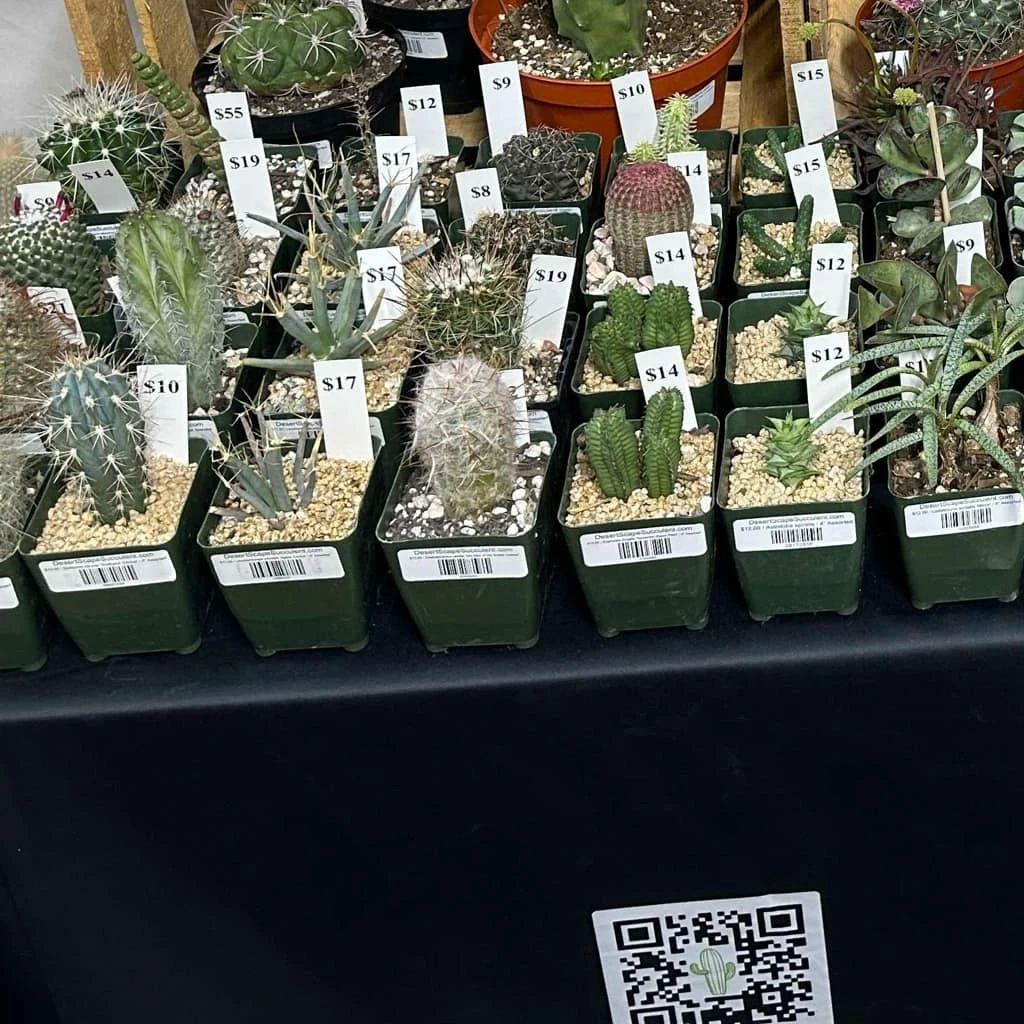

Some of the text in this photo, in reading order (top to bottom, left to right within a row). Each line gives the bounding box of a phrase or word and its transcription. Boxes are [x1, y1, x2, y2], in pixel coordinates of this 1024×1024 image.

[491, 76, 512, 90] $9
[797, 68, 825, 82] $15
[617, 83, 646, 100] $10
[407, 96, 437, 111] $12
[213, 106, 245, 120] $55
[229, 154, 261, 170] $19
[381, 151, 412, 167] $17
[82, 169, 115, 181] $14
[792, 159, 821, 176] $15
[470, 184, 492, 198] $8
[956, 237, 975, 252] $9
[654, 247, 685, 263] $14
[815, 257, 846, 272] $12
[366, 266, 399, 283] $17
[534, 269, 567, 284] $19
[811, 346, 844, 363] $12
[645, 363, 680, 382] $14
[143, 379, 180, 395] $10
[322, 375, 357, 391] $17
